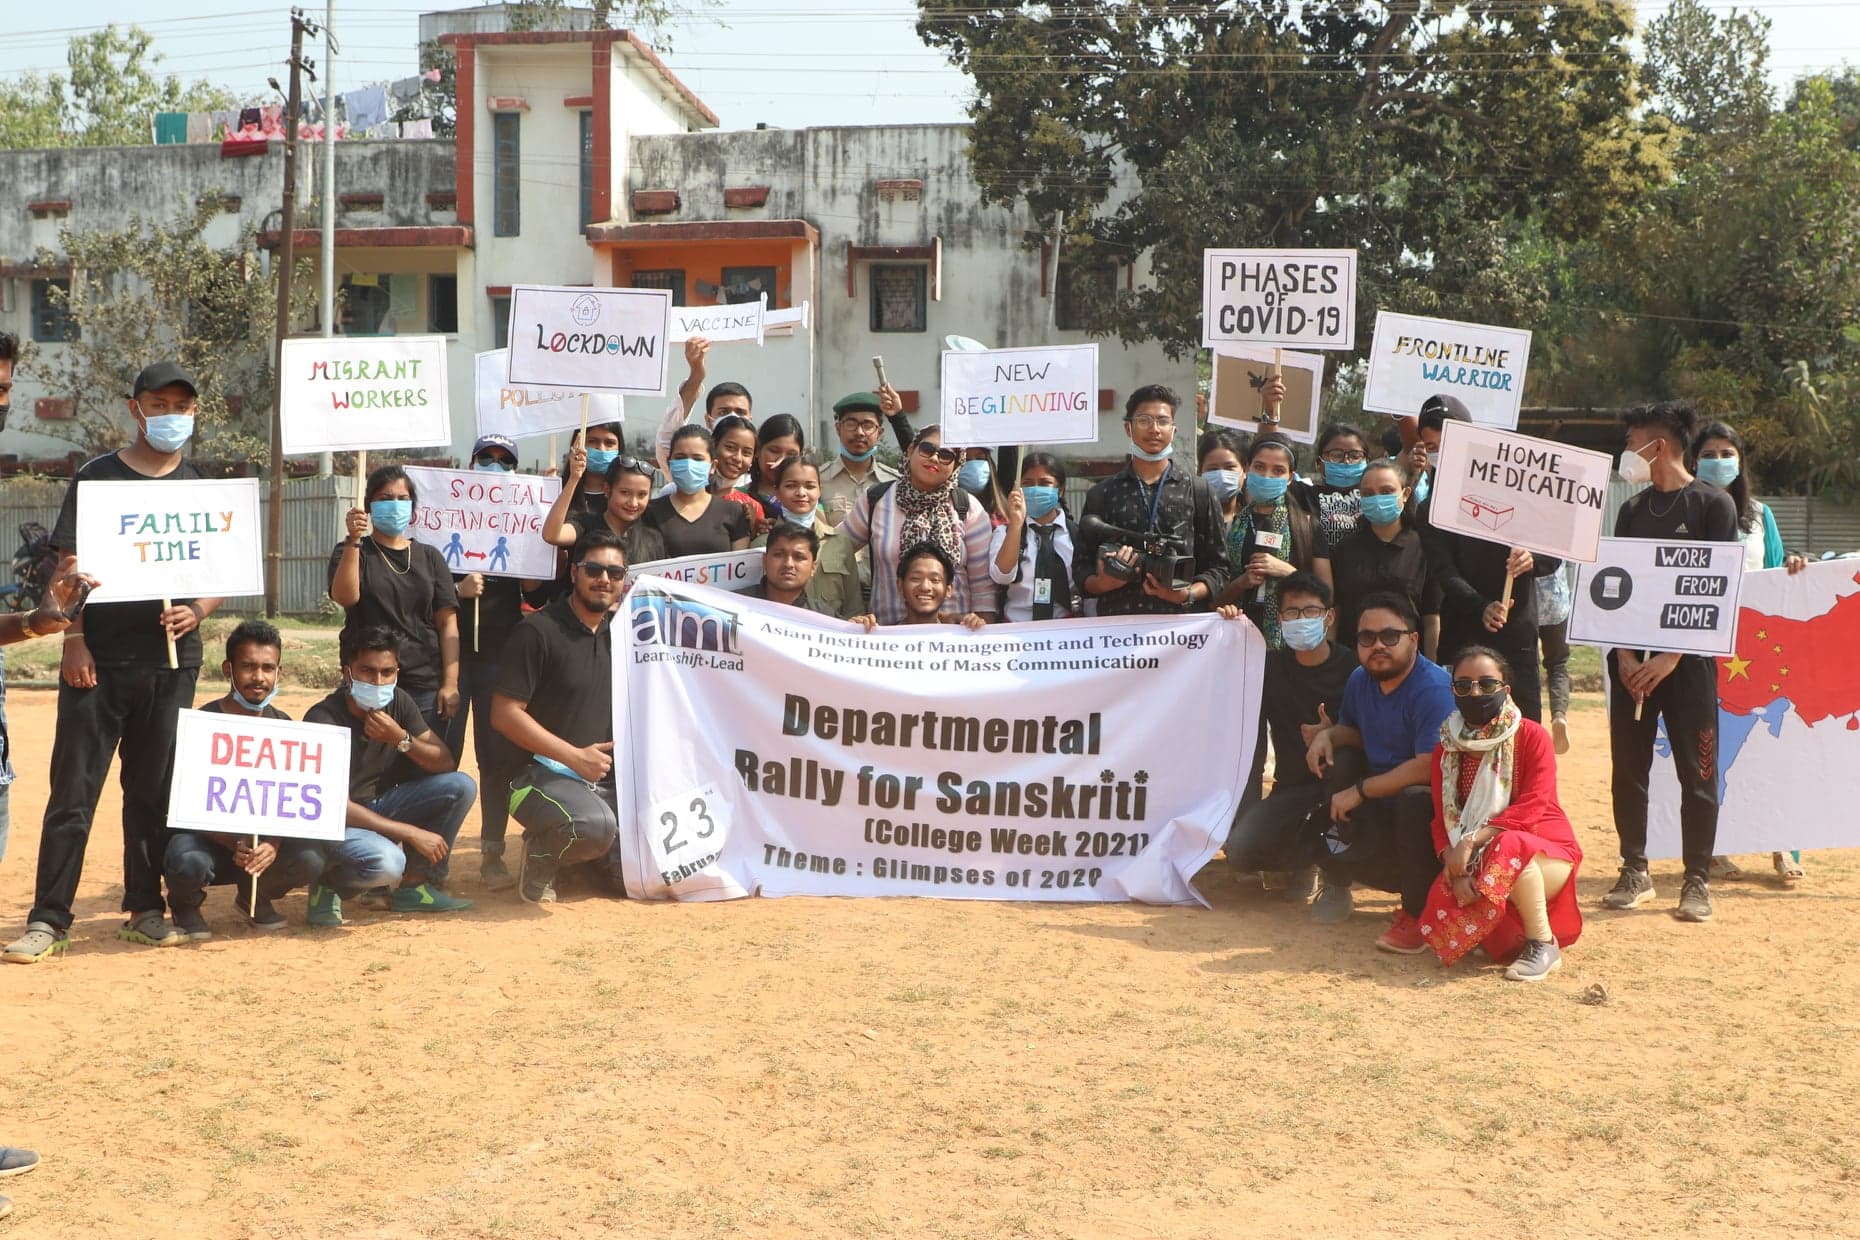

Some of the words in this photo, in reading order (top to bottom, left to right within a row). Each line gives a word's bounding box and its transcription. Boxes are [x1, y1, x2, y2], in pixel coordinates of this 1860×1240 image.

[1221, 262, 1338, 294] PHASES
[1264, 291, 1288, 306] OF
[680, 314, 756, 333] VACCINE
[1219, 305, 1340, 336] COVID-19
[536, 323, 656, 359] LOCKDOWN
[1391, 335, 1510, 369] FRONTLINE
[307, 359, 422, 381] MIGRANT
[993, 362, 1051, 383] NEW
[1422, 362, 1512, 391] WARRIOR
[331, 388, 428, 410] WORKERS
[954, 391, 1088, 416] BEGINNING
[1497, 442, 1563, 475] HOME
[450, 479, 553, 506] SOCIAL
[1469, 458, 1604, 510] MEDICATION
[118, 511, 233, 535] FAMILY
[133, 540, 201, 562] TIME
[1680, 576, 1721, 595] FROM
[1666, 605, 1715, 628] HOME
[760, 622, 812, 642] Asian
[818, 632, 900, 653] Institute
[904, 639, 923, 653] of
[928, 639, 1053, 656] Management
[1058, 635, 1094, 650] and
[1099, 630, 1209, 650] Technology
[710, 655, 744, 671] Lead
[807, 647, 924, 670] Department
[929, 658, 949, 672] of
[954, 659, 1001, 672] Mass
[1007, 653, 1160, 671] Communication
[783, 692, 1102, 755] Departmental
[211, 732, 323, 774] DEATH
[206, 776, 323, 821] RATES
[734, 748, 844, 807] Rally
[857, 765, 923, 810] for
[936, 768, 1149, 821] Sanskriti
[660, 797, 715, 855] 23
[864, 818, 982, 853] (College
[991, 828, 1067, 857] Week
[1075, 831, 1150, 858] 2021)
[763, 843, 847, 875] Theme
[873, 857, 995, 886] Glimpses
[1006, 868, 1032, 888] of
